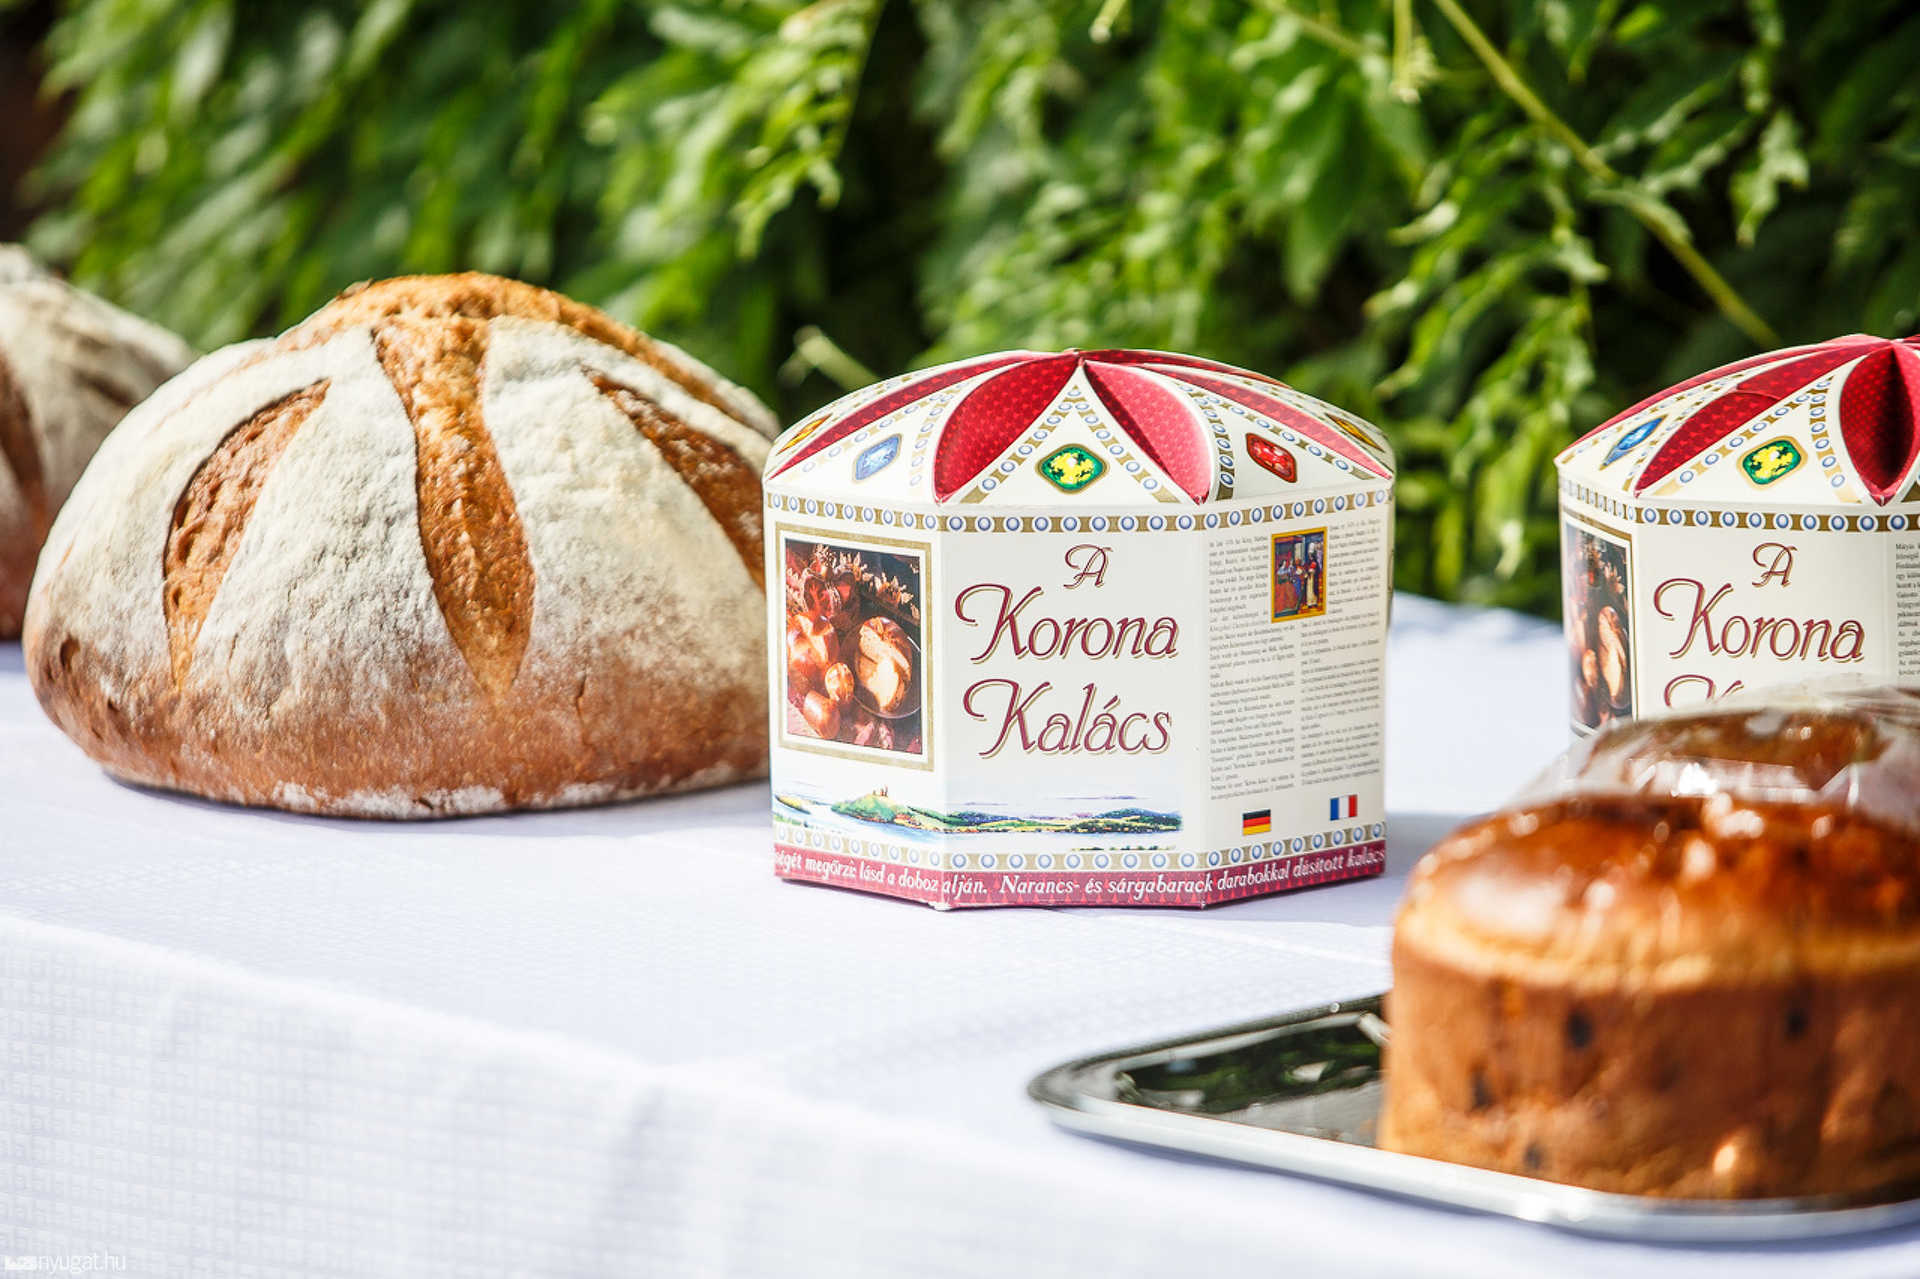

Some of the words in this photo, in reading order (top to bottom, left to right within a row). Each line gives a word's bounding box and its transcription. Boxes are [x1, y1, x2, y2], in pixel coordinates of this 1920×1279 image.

[1063, 544, 1113, 589] A
[1752, 542, 1798, 588] A
[955, 583, 1179, 665] Korona
[1653, 578, 1865, 663] Korona
[963, 679, 1172, 760] Kalács
[859, 861, 885, 884] lásd
[887, 871, 896, 885] a
[898, 868, 939, 892] doboz
[943, 875, 988, 900] alján.
[1000, 875, 1080, 894] Narancs-
[1085, 878, 1104, 894] és
[1107, 873, 1213, 900] sárgabarack
[1217, 860, 1291, 891] darabokkal
